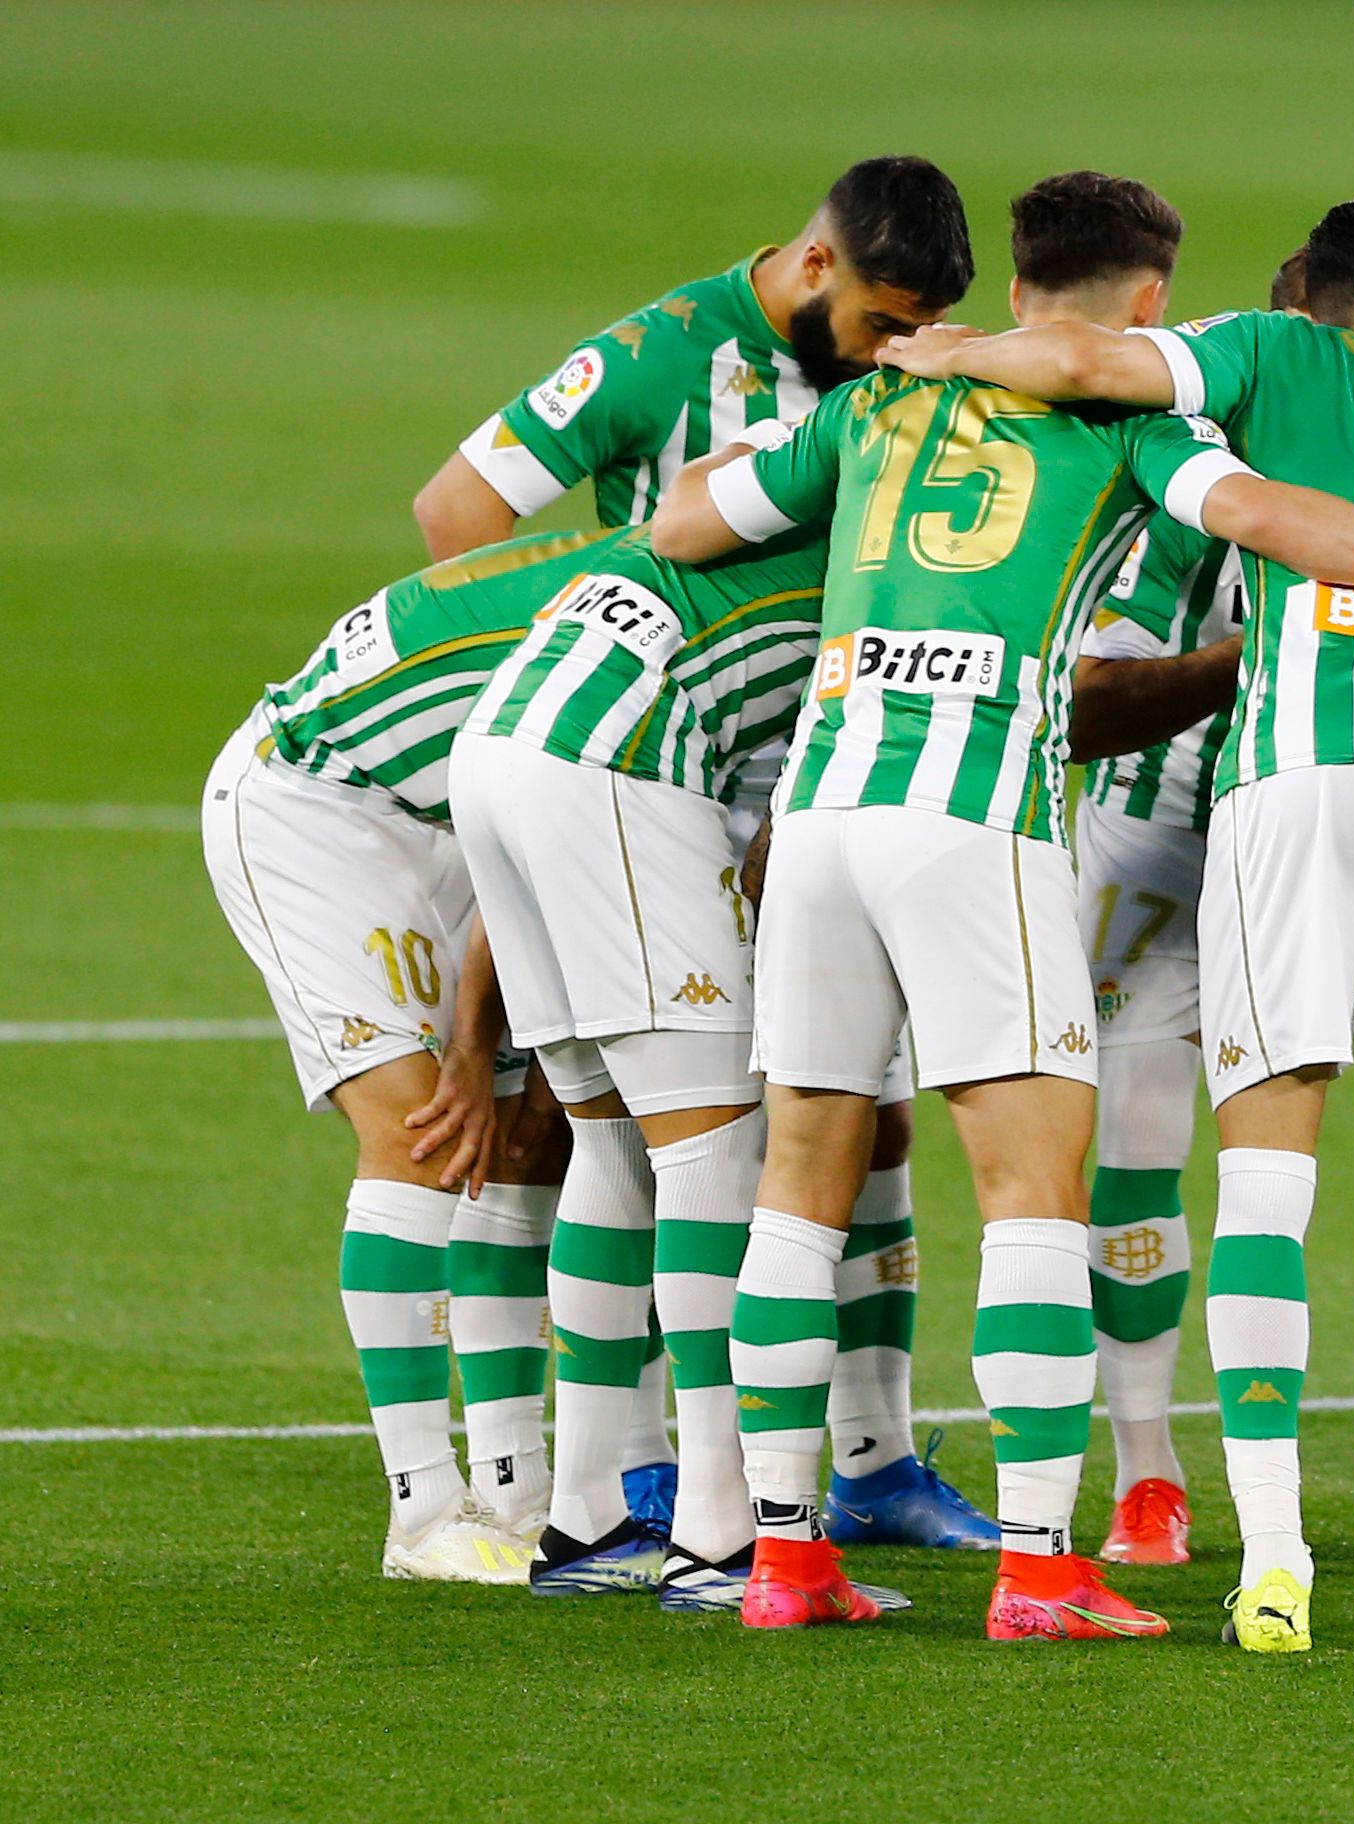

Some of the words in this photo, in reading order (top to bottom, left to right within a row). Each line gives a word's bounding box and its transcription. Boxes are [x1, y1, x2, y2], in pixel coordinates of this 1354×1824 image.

[853, 384, 1052, 573] 15
[1091, 883, 1180, 967] 17
[362, 926, 441, 1009] 10
